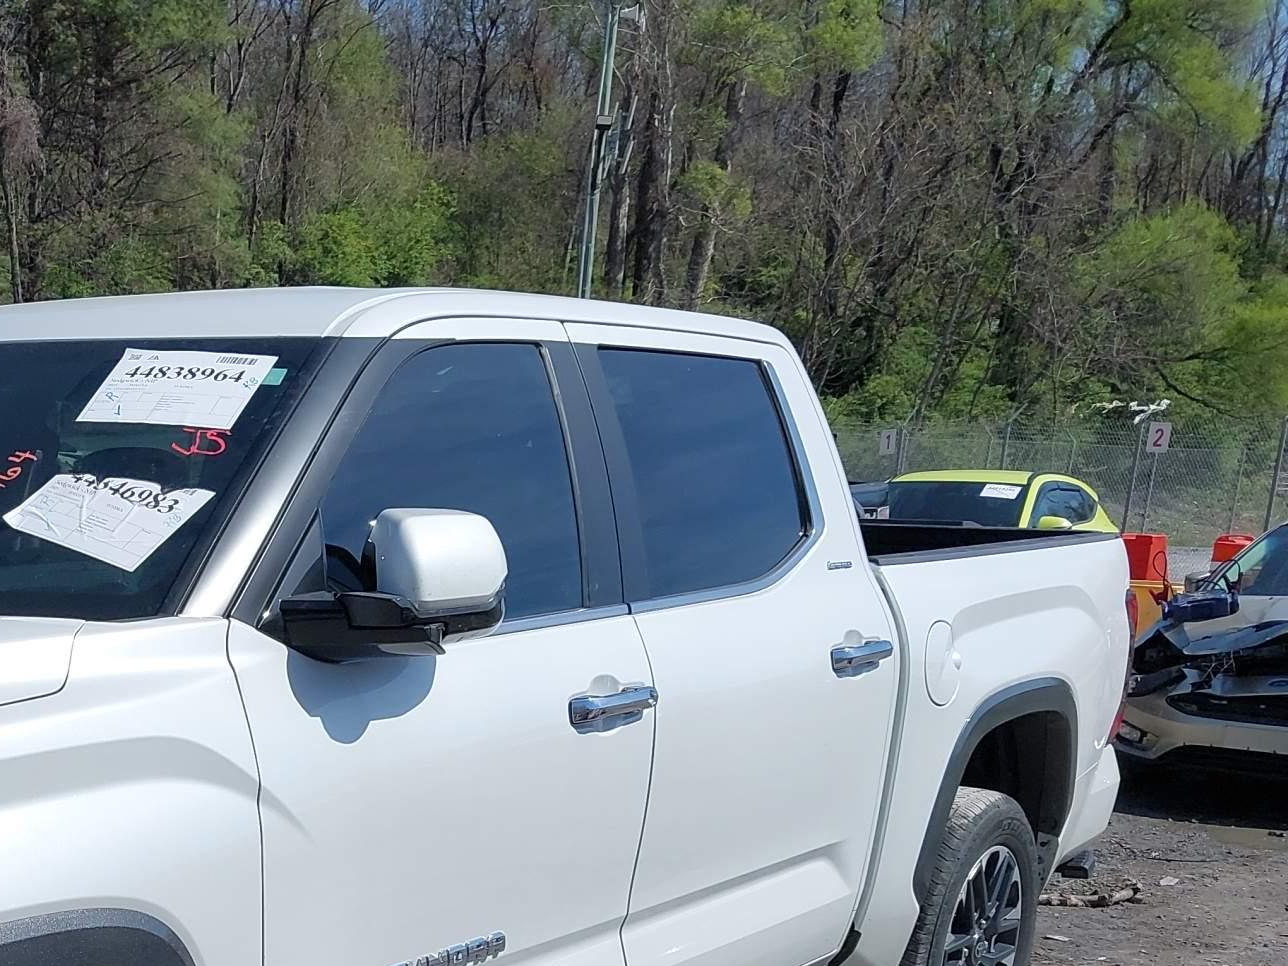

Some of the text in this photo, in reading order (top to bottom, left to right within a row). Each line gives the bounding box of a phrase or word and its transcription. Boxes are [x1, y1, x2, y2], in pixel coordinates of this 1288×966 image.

[124, 365, 247, 383] 44838964
[886, 434, 891, 450] 1
[1152, 428, 1164, 448] 2
